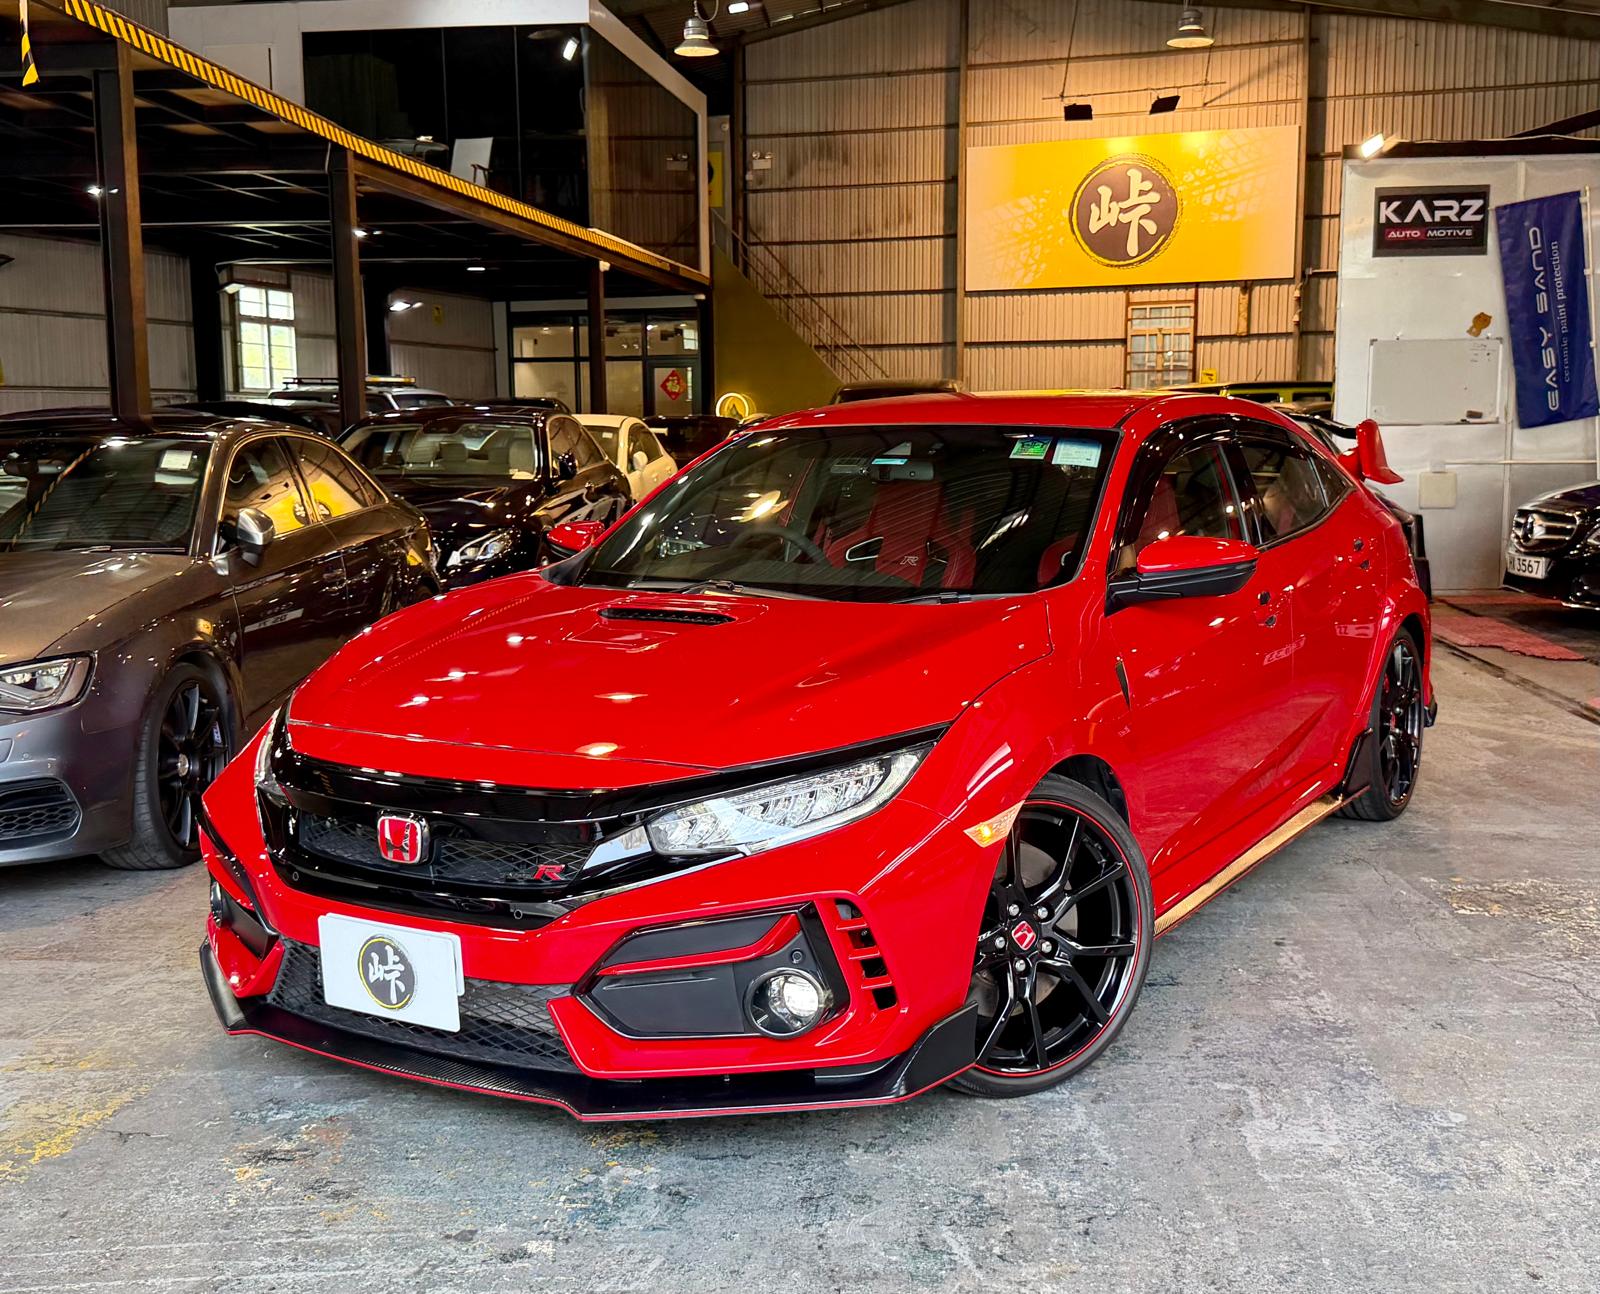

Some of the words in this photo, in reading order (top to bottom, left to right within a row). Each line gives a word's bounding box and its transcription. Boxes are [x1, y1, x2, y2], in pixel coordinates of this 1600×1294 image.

[1088, 168, 1160, 257] 峠
[1379, 199, 1485, 224] KARZ
[1387, 230, 1421, 239] AUTO
[1426, 229, 1473, 238] MOTIVE
[1528, 226, 1549, 314] SAND
[1550, 240, 1567, 300] protection
[1556, 303, 1569, 333] paint
[1539, 326, 1560, 411] EASY
[1561, 336, 1570, 382] ceramic
[1516, 557, 1541, 575] 3567
[533, 864, 566, 881] R
[368, 944, 406, 1004] 峠
